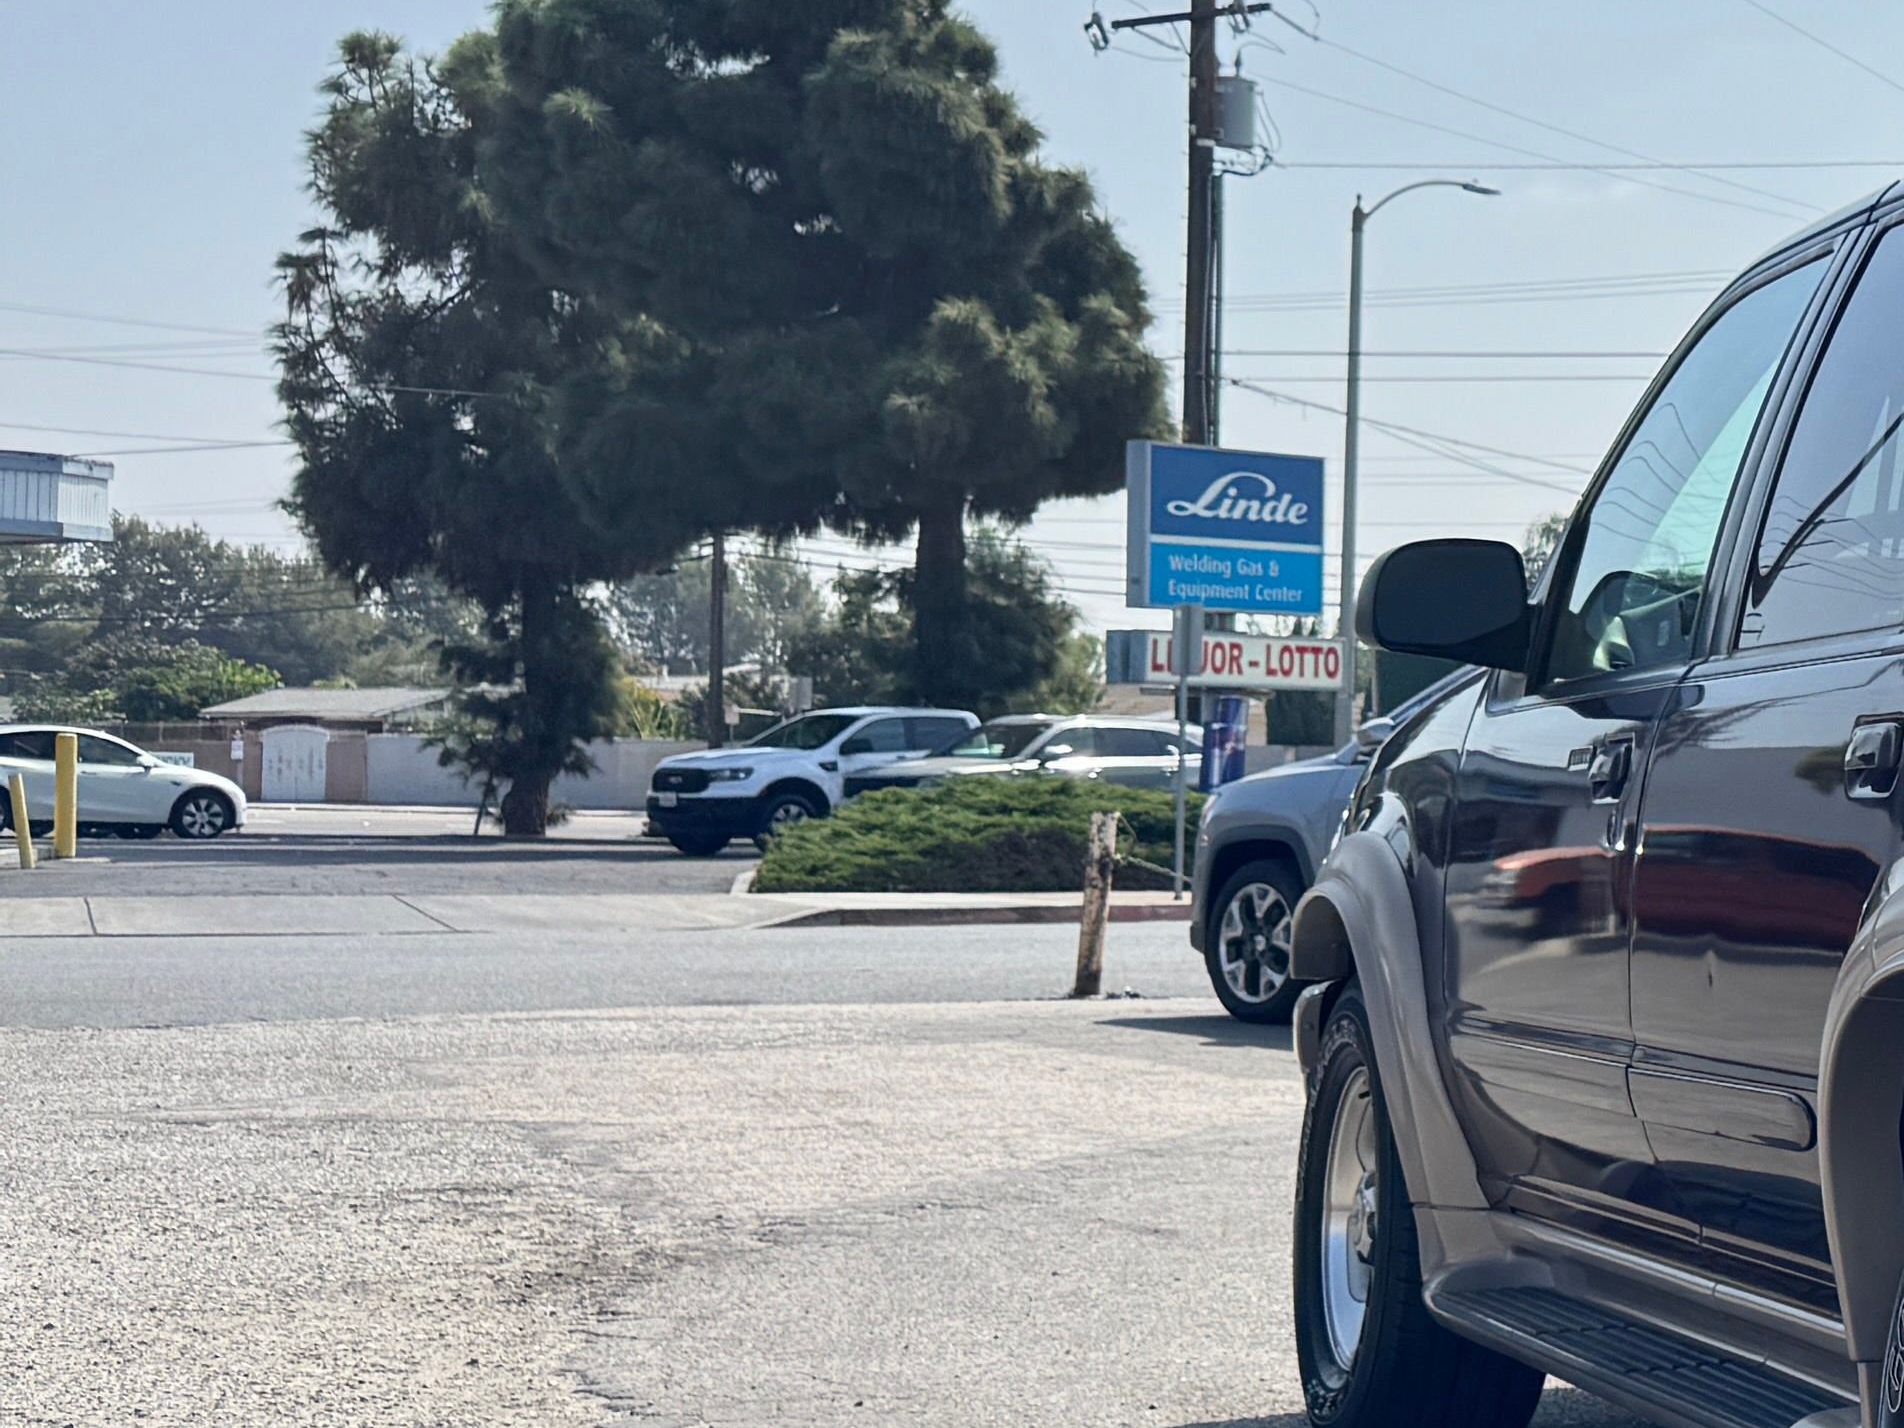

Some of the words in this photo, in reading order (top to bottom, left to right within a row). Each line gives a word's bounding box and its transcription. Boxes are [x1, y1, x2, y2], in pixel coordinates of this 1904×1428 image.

[1167, 471, 1308, 525] Linde
[1168, 553, 1231, 579] Welding
[1237, 557, 1264, 577] Gas
[1269, 559, 1279, 578] &
[1168, 579, 1249, 602] Equipment
[1255, 584, 1302, 602] Center
[1151, 638, 1244, 676] LIOR
[1265, 643, 1340, 679] LOTTO
